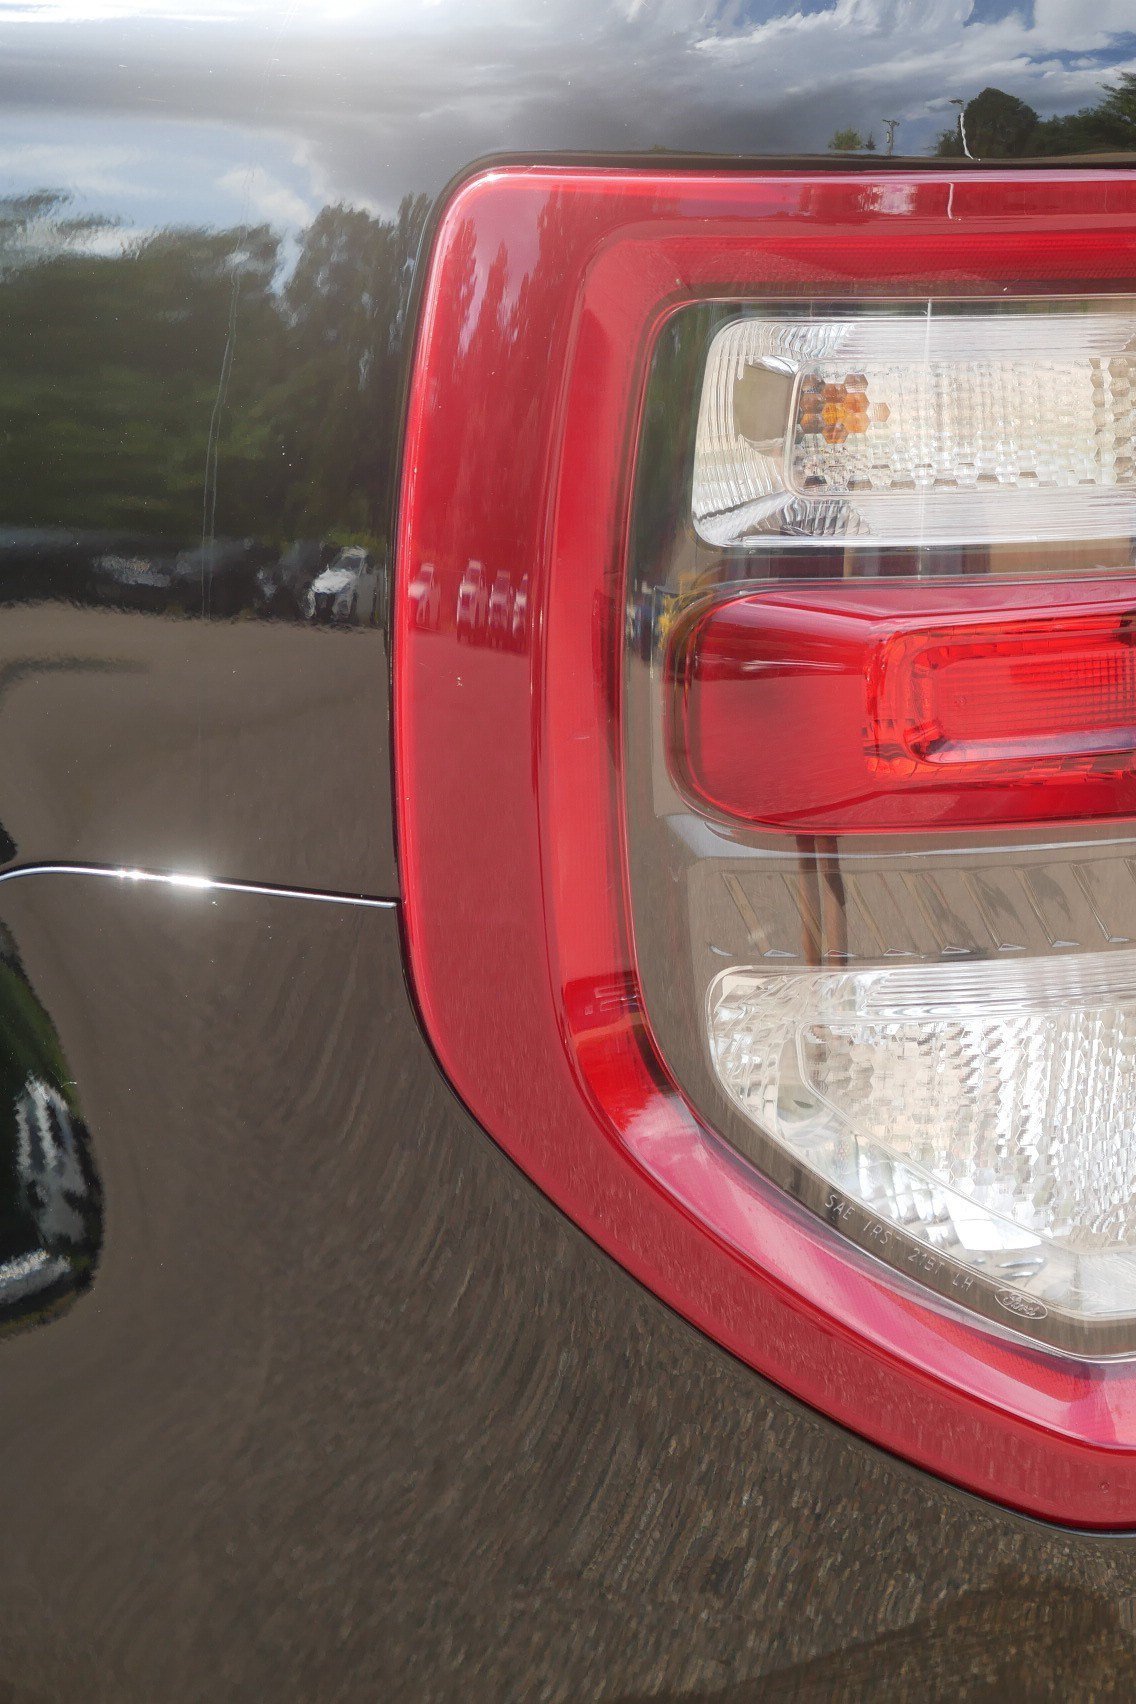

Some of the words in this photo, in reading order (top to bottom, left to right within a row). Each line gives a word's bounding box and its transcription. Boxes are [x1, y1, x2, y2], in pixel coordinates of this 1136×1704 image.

[824, 1194, 856, 1220] SAE
[952, 1273, 974, 1292] LH
[1002, 1291, 1041, 1316] Ford
